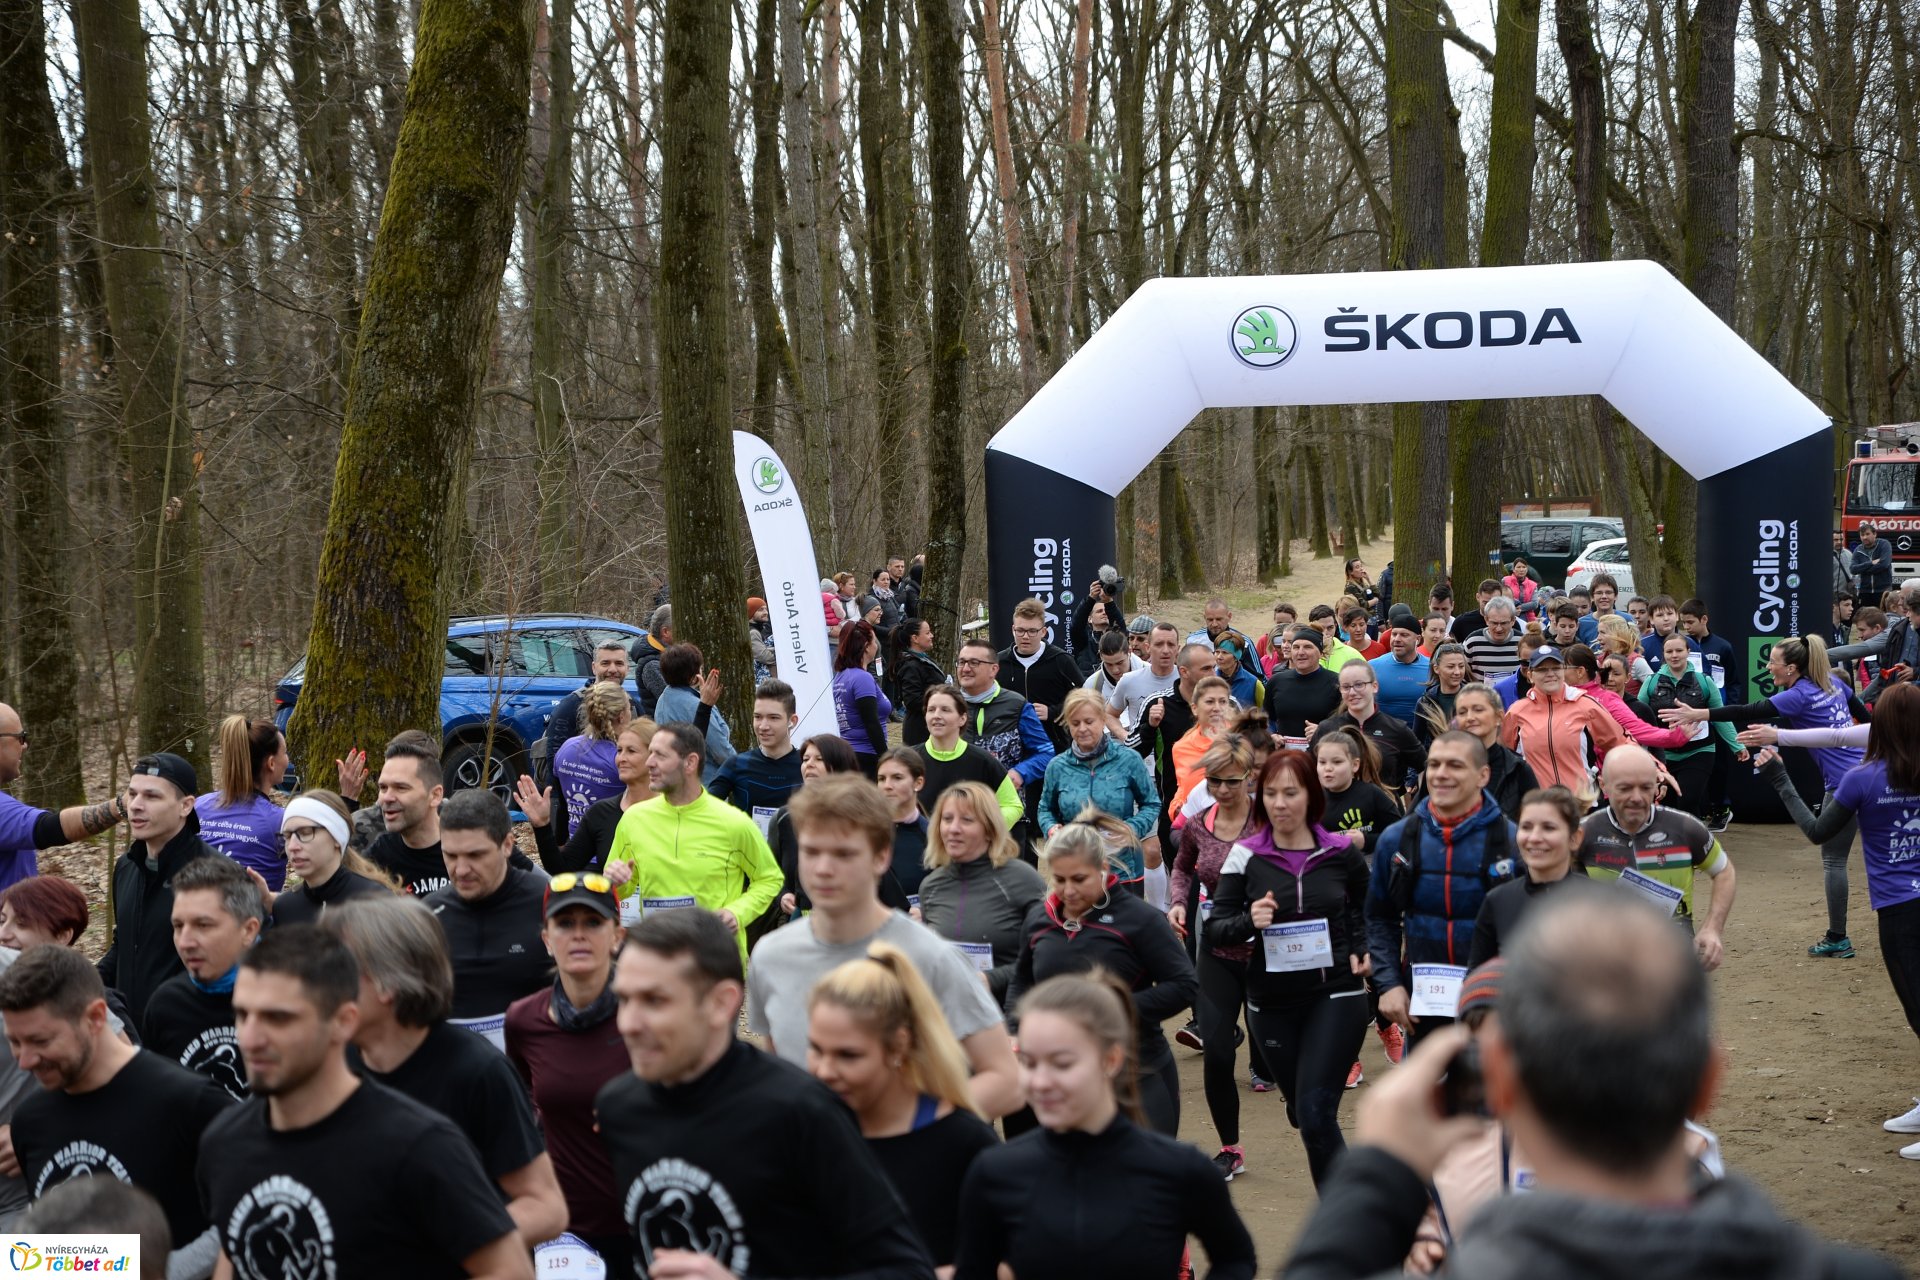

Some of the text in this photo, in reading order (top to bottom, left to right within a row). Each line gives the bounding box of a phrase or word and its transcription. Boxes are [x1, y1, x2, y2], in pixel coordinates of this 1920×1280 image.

[1324, 306, 1582, 352] ŠKODA
[1787, 519, 1799, 570] ŠKODA
[1061, 538, 1072, 587] ŠKODA
[1753, 519, 1786, 633] Cycling
[1789, 604, 1801, 638] ajtóereje
[235, 833, 260, 844] vagyok.
[1286, 943, 1305, 953] 192
[1429, 985, 1446, 994] 191
[53, 1140, 107, 1162] WARRIOR
[251, 1174, 312, 1206] WARRIOR
[547, 1256, 569, 1269] 119
